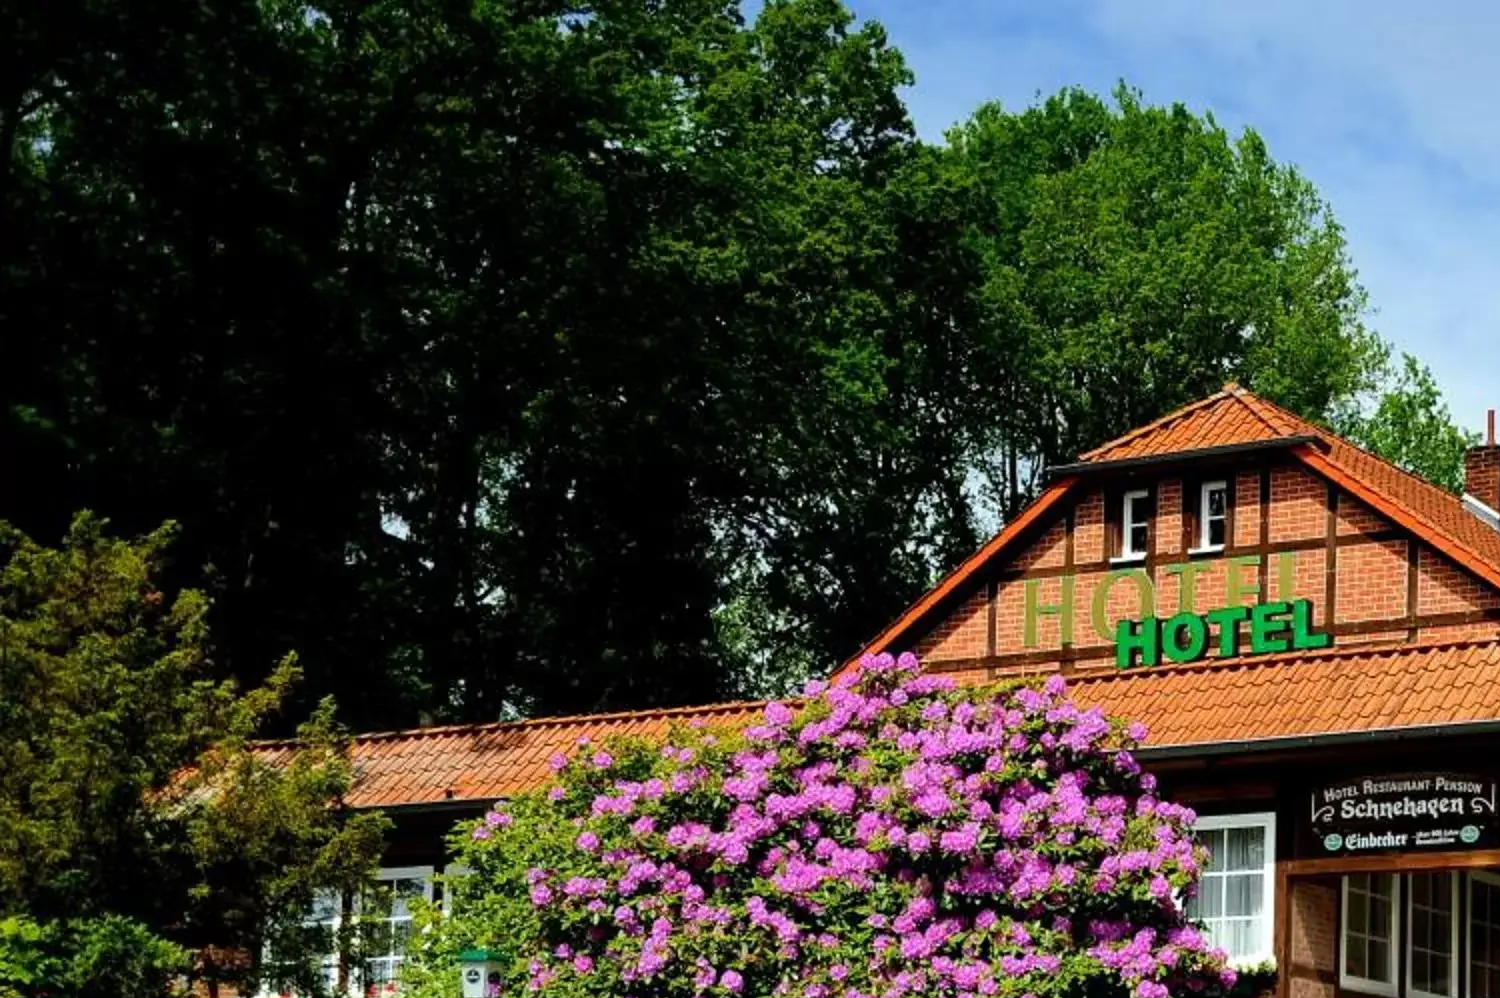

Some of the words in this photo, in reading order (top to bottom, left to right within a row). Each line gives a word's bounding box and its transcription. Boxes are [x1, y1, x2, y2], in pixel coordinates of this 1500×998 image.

[1115, 599, 1334, 669] HOTEL
[1323, 786, 1359, 802] HOTEL
[1362, 780, 1430, 794] RESTAURANT
[1435, 777, 1482, 794] PENSION
[1341, 797, 1464, 819] Schnehagen
